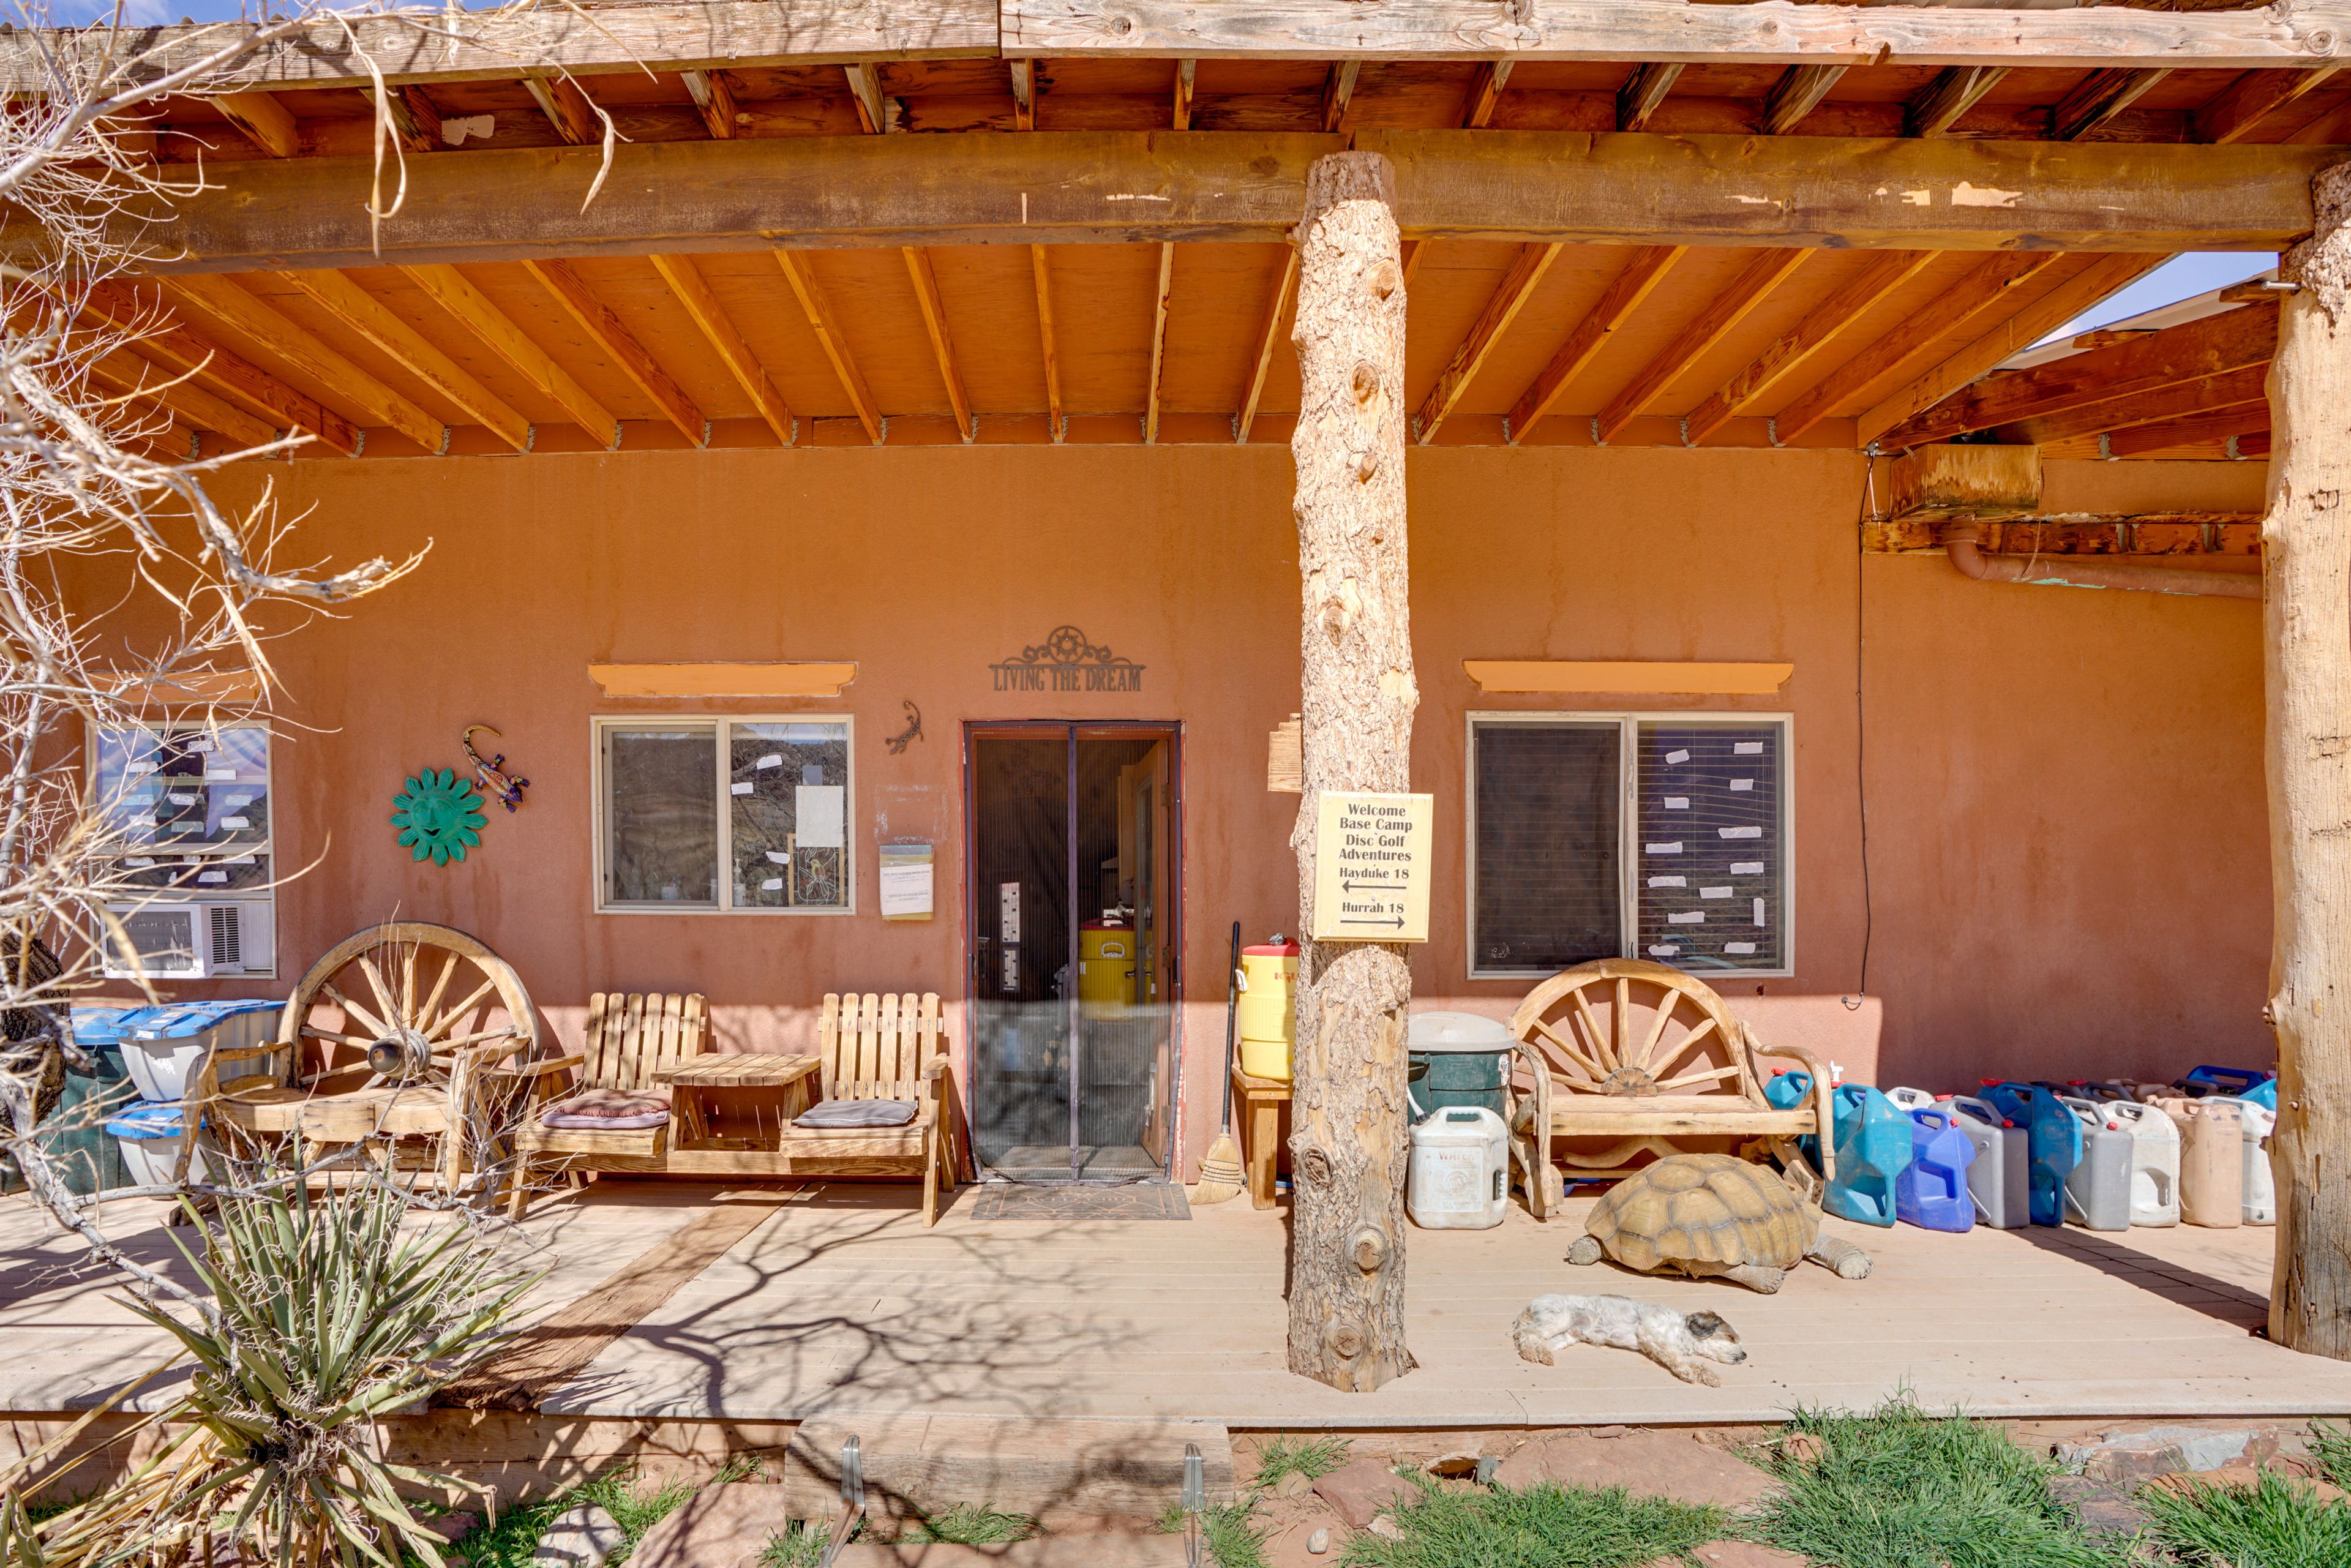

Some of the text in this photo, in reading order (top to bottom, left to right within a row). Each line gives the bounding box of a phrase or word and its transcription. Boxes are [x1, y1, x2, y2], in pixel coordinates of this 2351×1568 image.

[993, 665, 1141, 692] LIVING THE DREAM
[1348, 803, 1406, 817] Welcome
[1340, 817, 1412, 833] Base Camp
[1346, 834, 1406, 847] Disc Golf
[1339, 848, 1412, 861] Adventures
[1340, 867, 1409, 880] Hayduke 18
[1342, 902, 1404, 913] Hurrah 18
[1274, 972, 1298, 983] IGL
